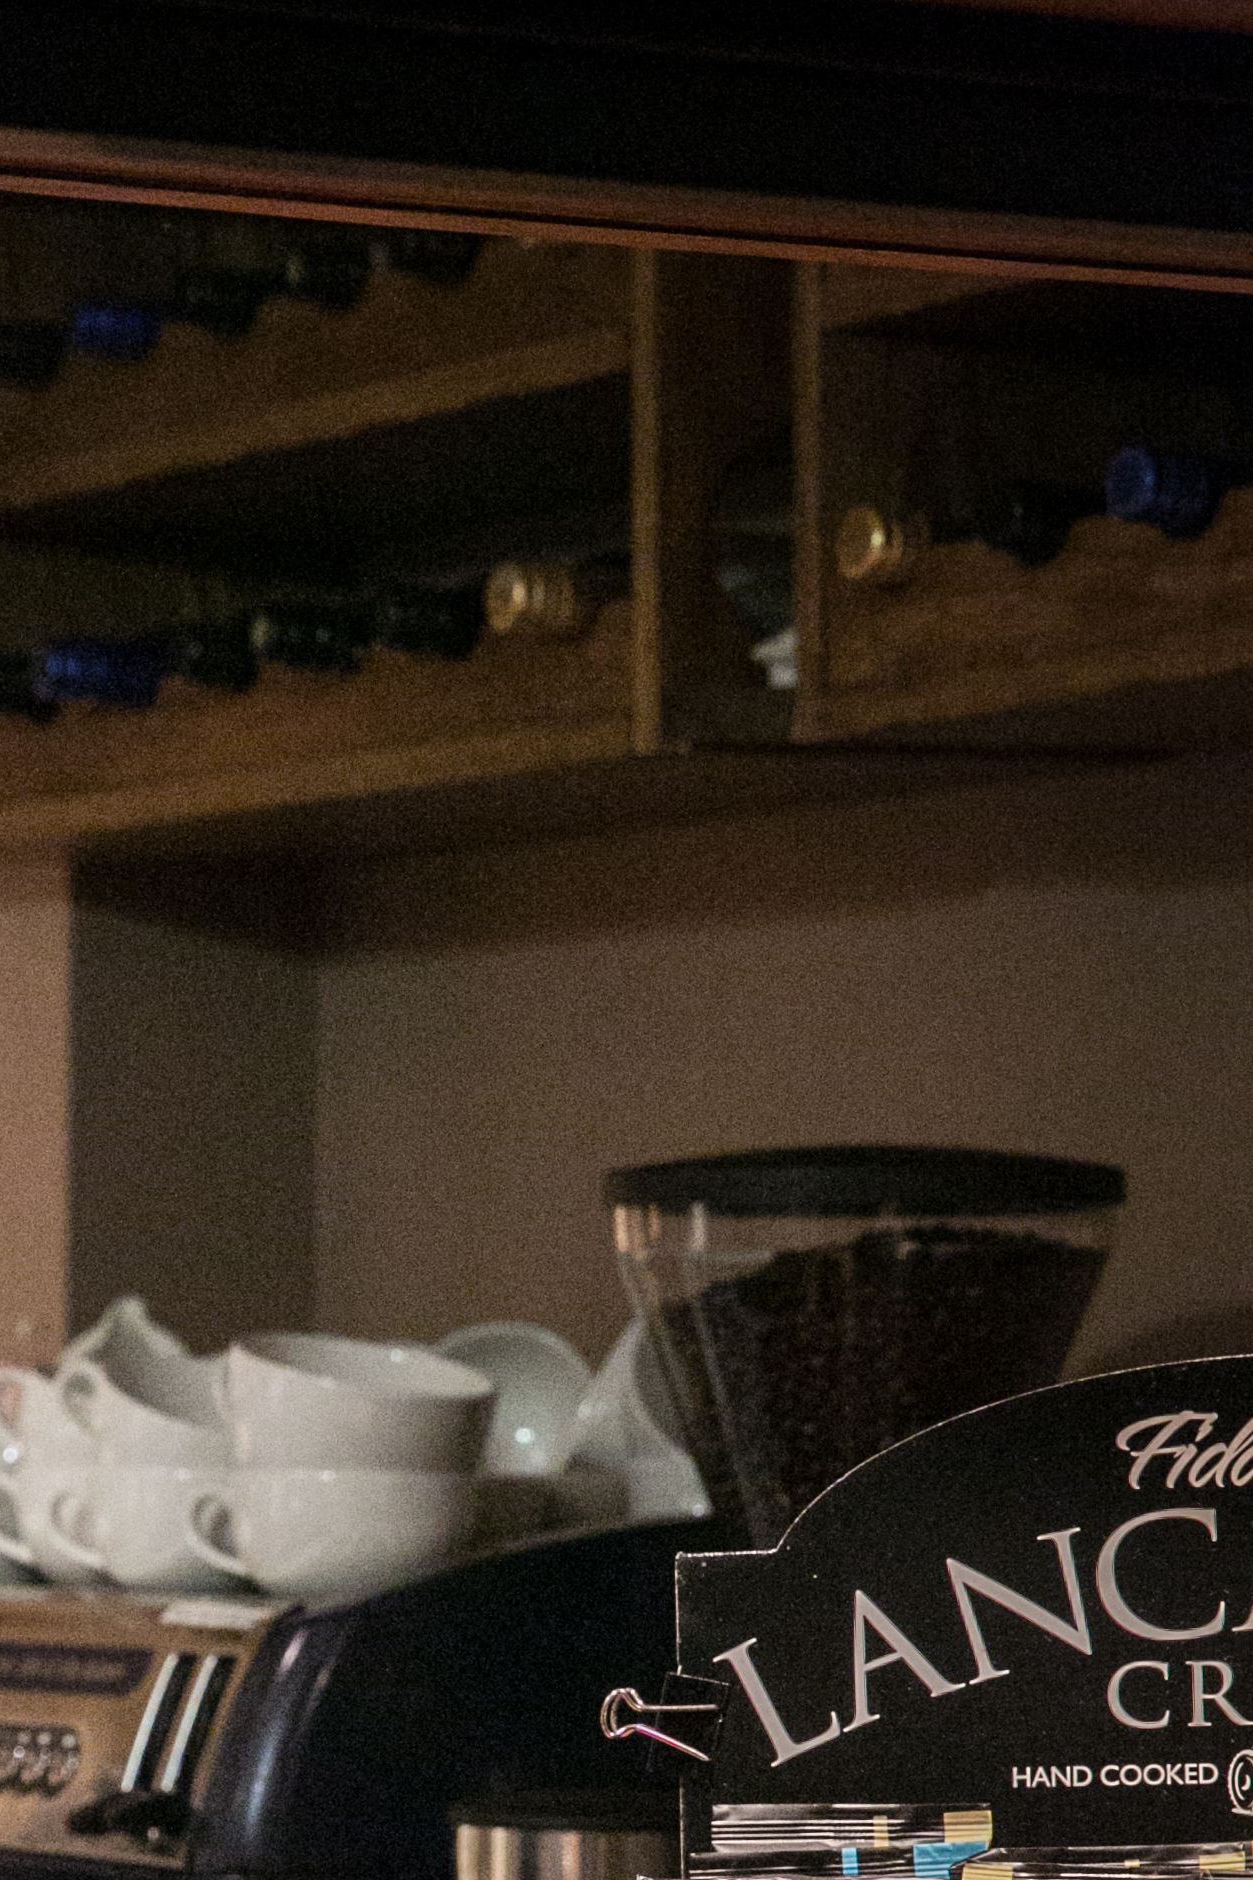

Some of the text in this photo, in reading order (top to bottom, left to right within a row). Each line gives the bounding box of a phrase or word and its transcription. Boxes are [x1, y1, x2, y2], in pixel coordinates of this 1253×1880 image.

[713, 1508, 1253, 1767] LANC
[1012, 1763, 1218, 1788] HAND COOKED
